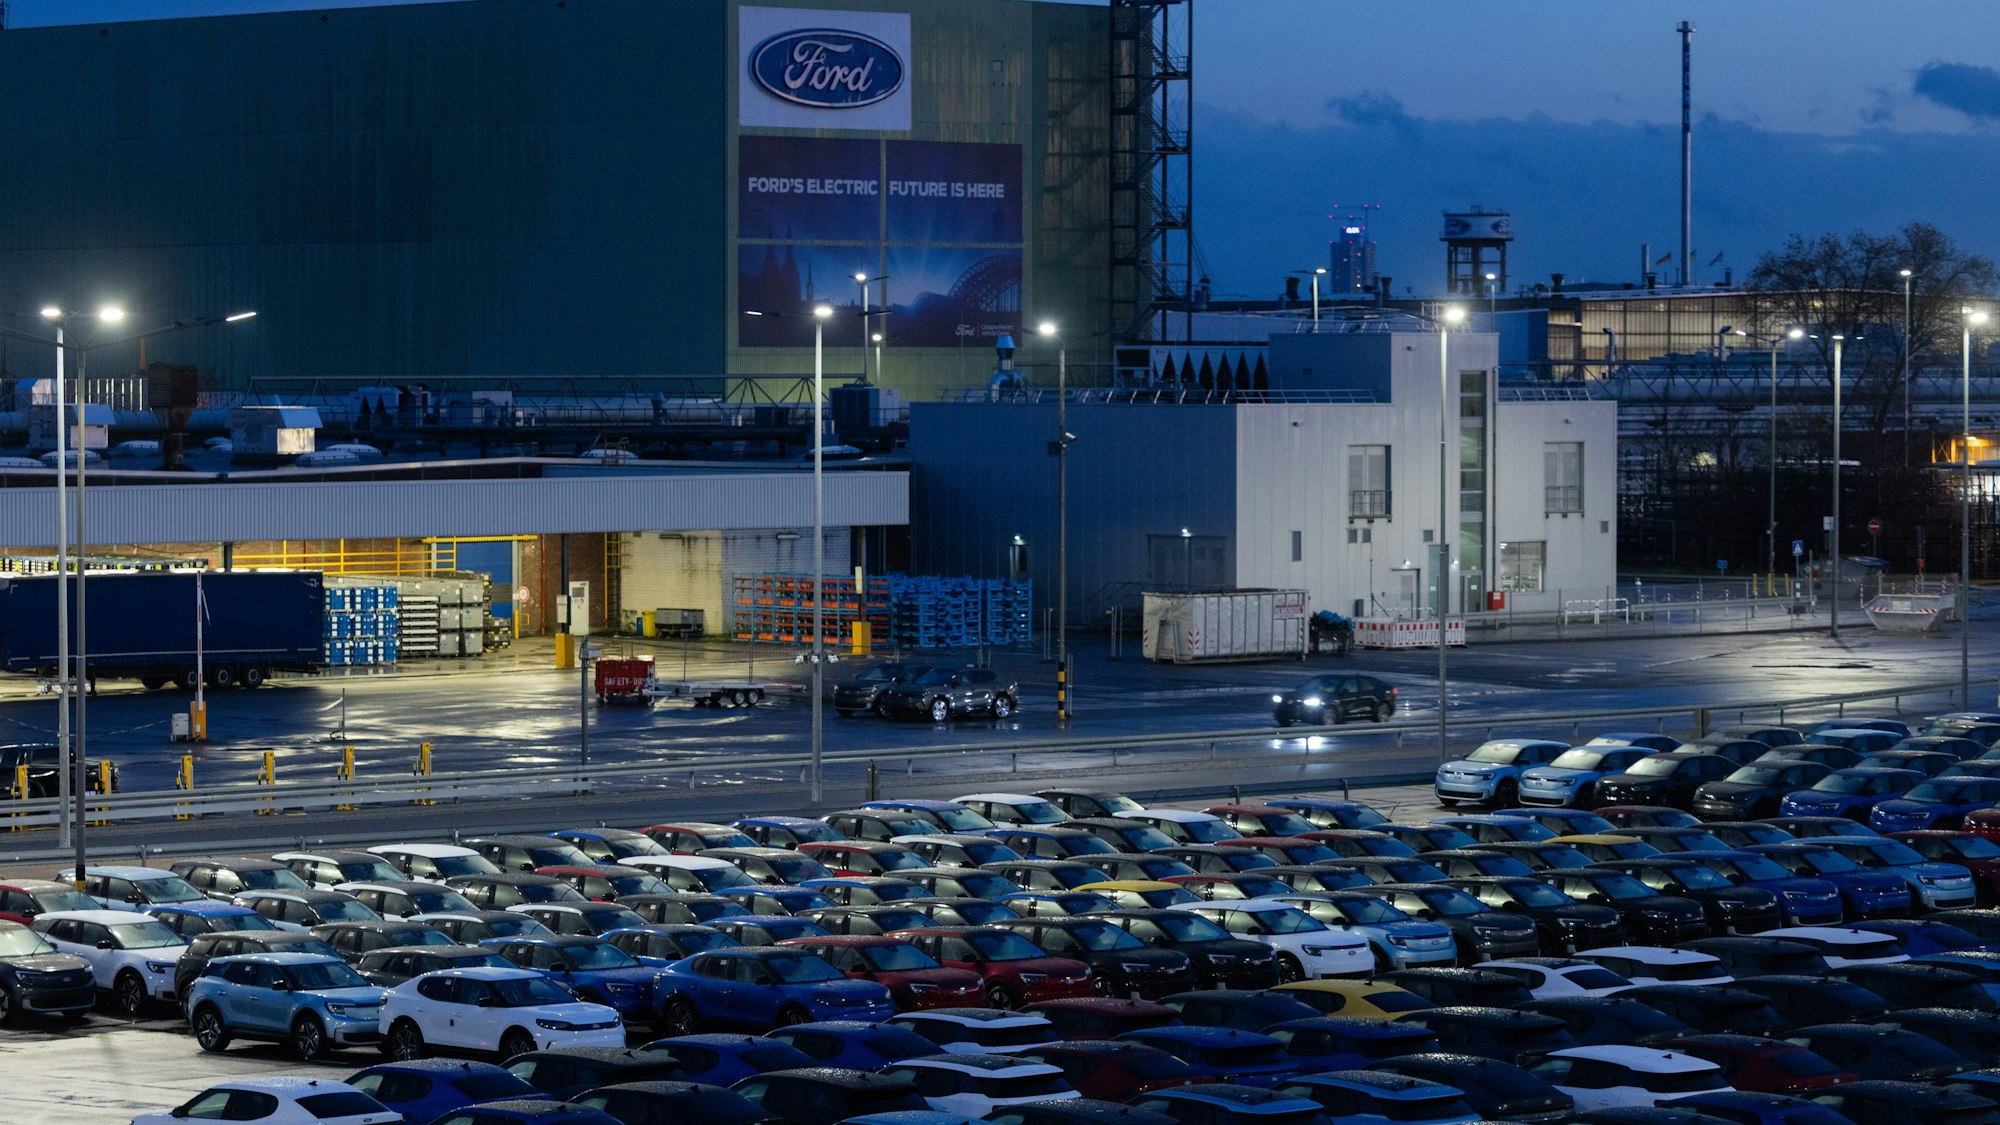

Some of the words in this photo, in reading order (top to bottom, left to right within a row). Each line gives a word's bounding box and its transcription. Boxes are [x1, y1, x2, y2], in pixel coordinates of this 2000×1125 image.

[784, 40, 875, 92] Ford
[748, 177, 804, 194] FORD'S
[807, 179, 878, 195] ELECTRIC
[890, 181, 947, 197] FUTURE
[951, 182, 965, 197] IS
[967, 183, 1005, 198] HERE
[955, 324, 976, 336] Ford
